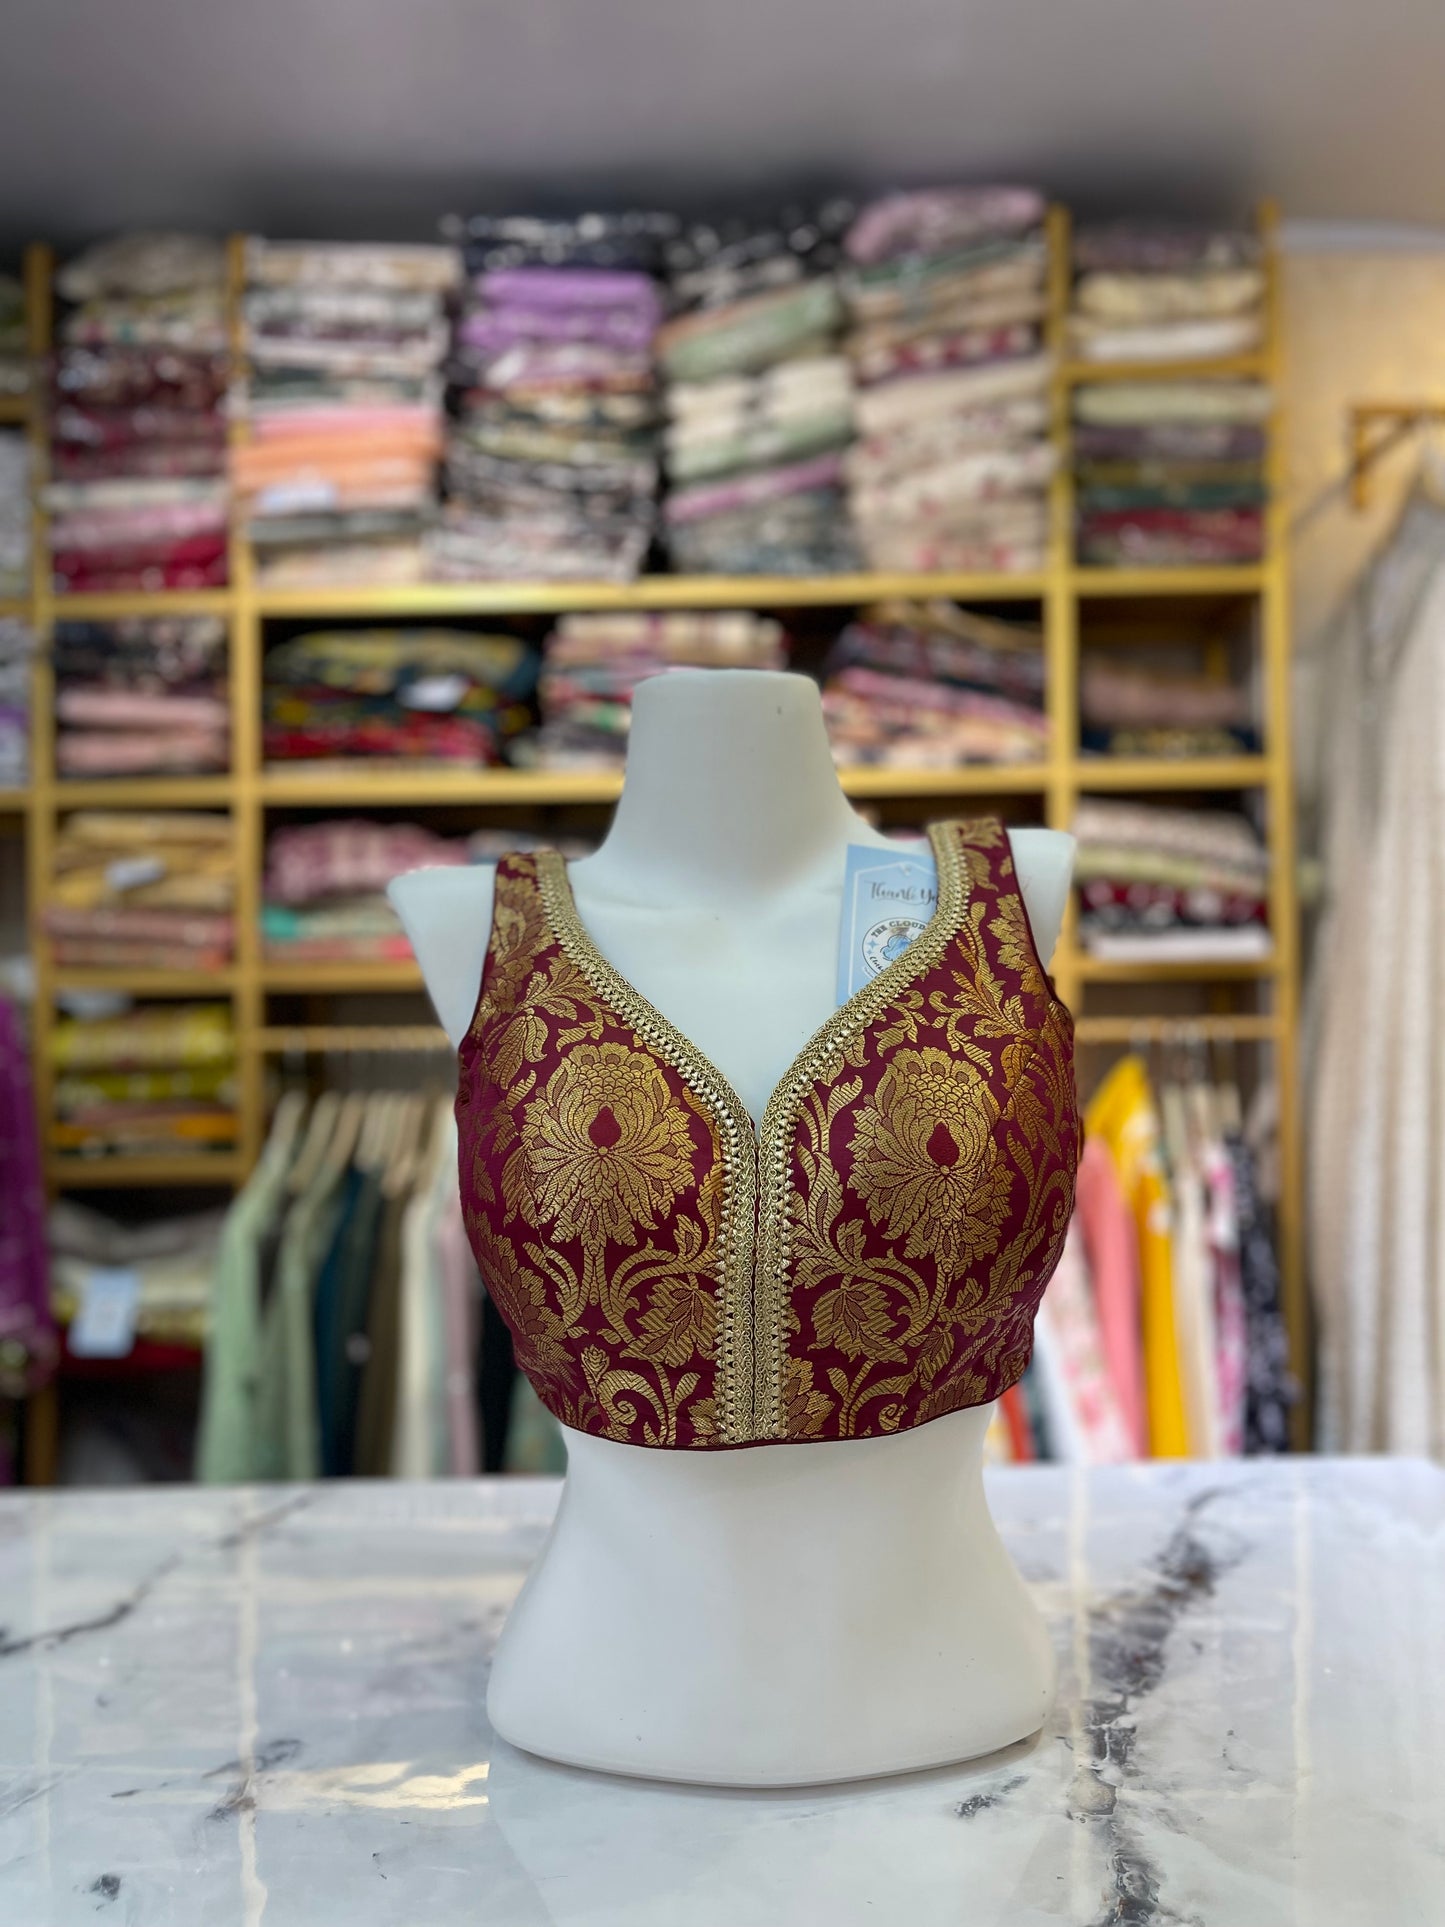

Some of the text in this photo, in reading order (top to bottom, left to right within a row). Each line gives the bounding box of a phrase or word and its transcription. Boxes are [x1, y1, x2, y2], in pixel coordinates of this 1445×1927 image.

[866, 881, 939, 905] Thank Yo
[871, 924, 888, 938] THE
[869, 956, 885, 972] Cloth
